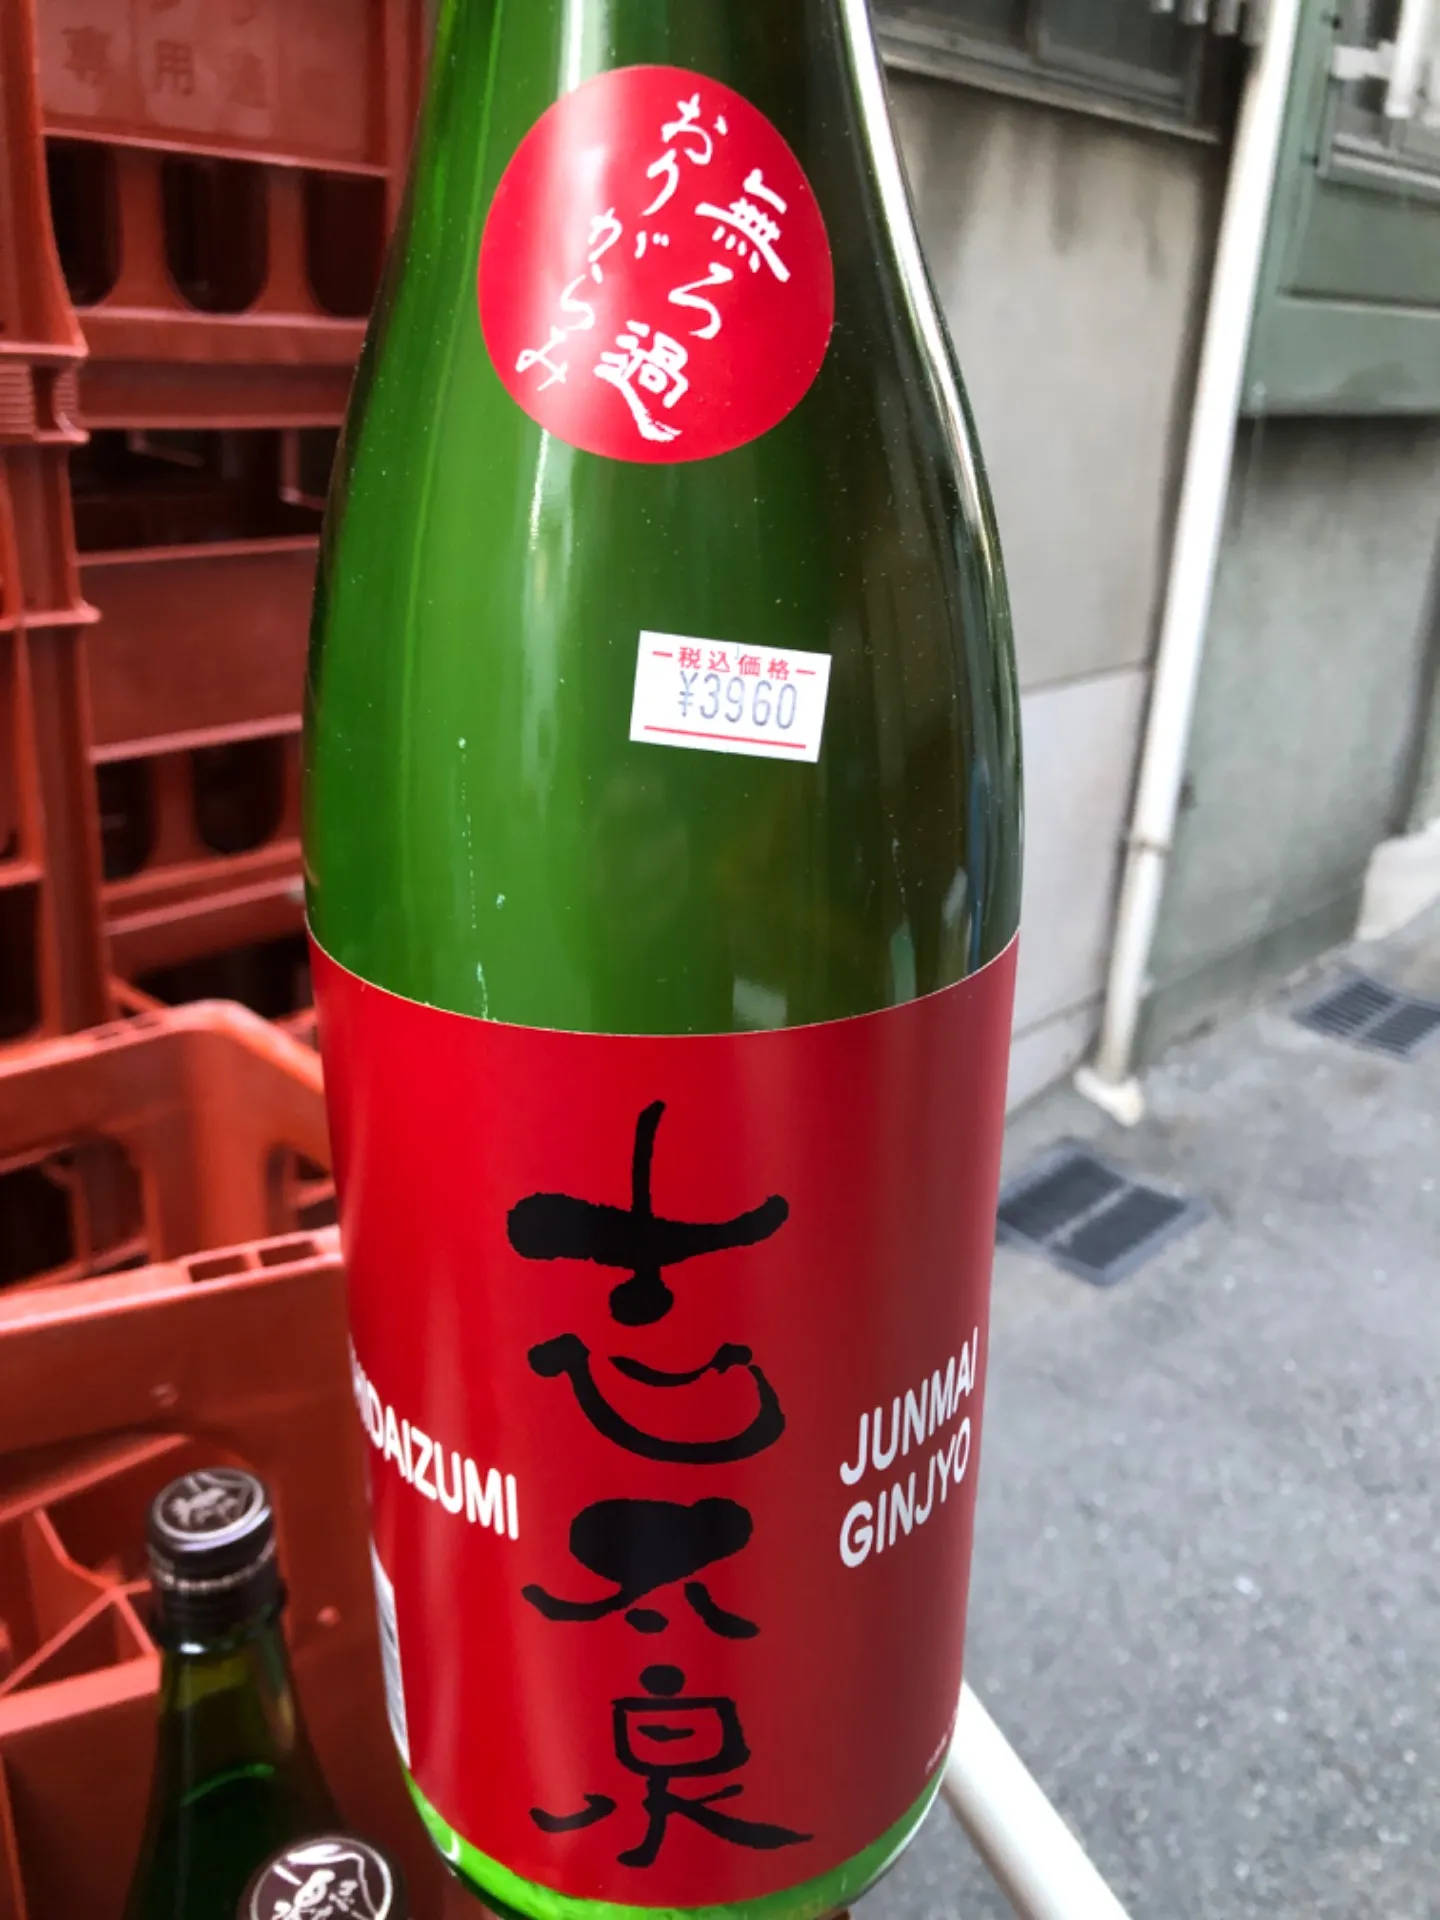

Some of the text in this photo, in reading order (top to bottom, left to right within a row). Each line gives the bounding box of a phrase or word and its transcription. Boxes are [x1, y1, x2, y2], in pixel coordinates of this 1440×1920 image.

[514, 93, 728, 392] おりがらみ
[593, 167, 791, 442] 無ろ過
[677, 670, 798, 730] ¥3960
[678, 646, 790, 681] 税込価格
[506, 1099, 815, 1869] 志太泉
[839, 1325, 979, 1486] JUNMAI
[839, 1416, 971, 1568] GINJYO
